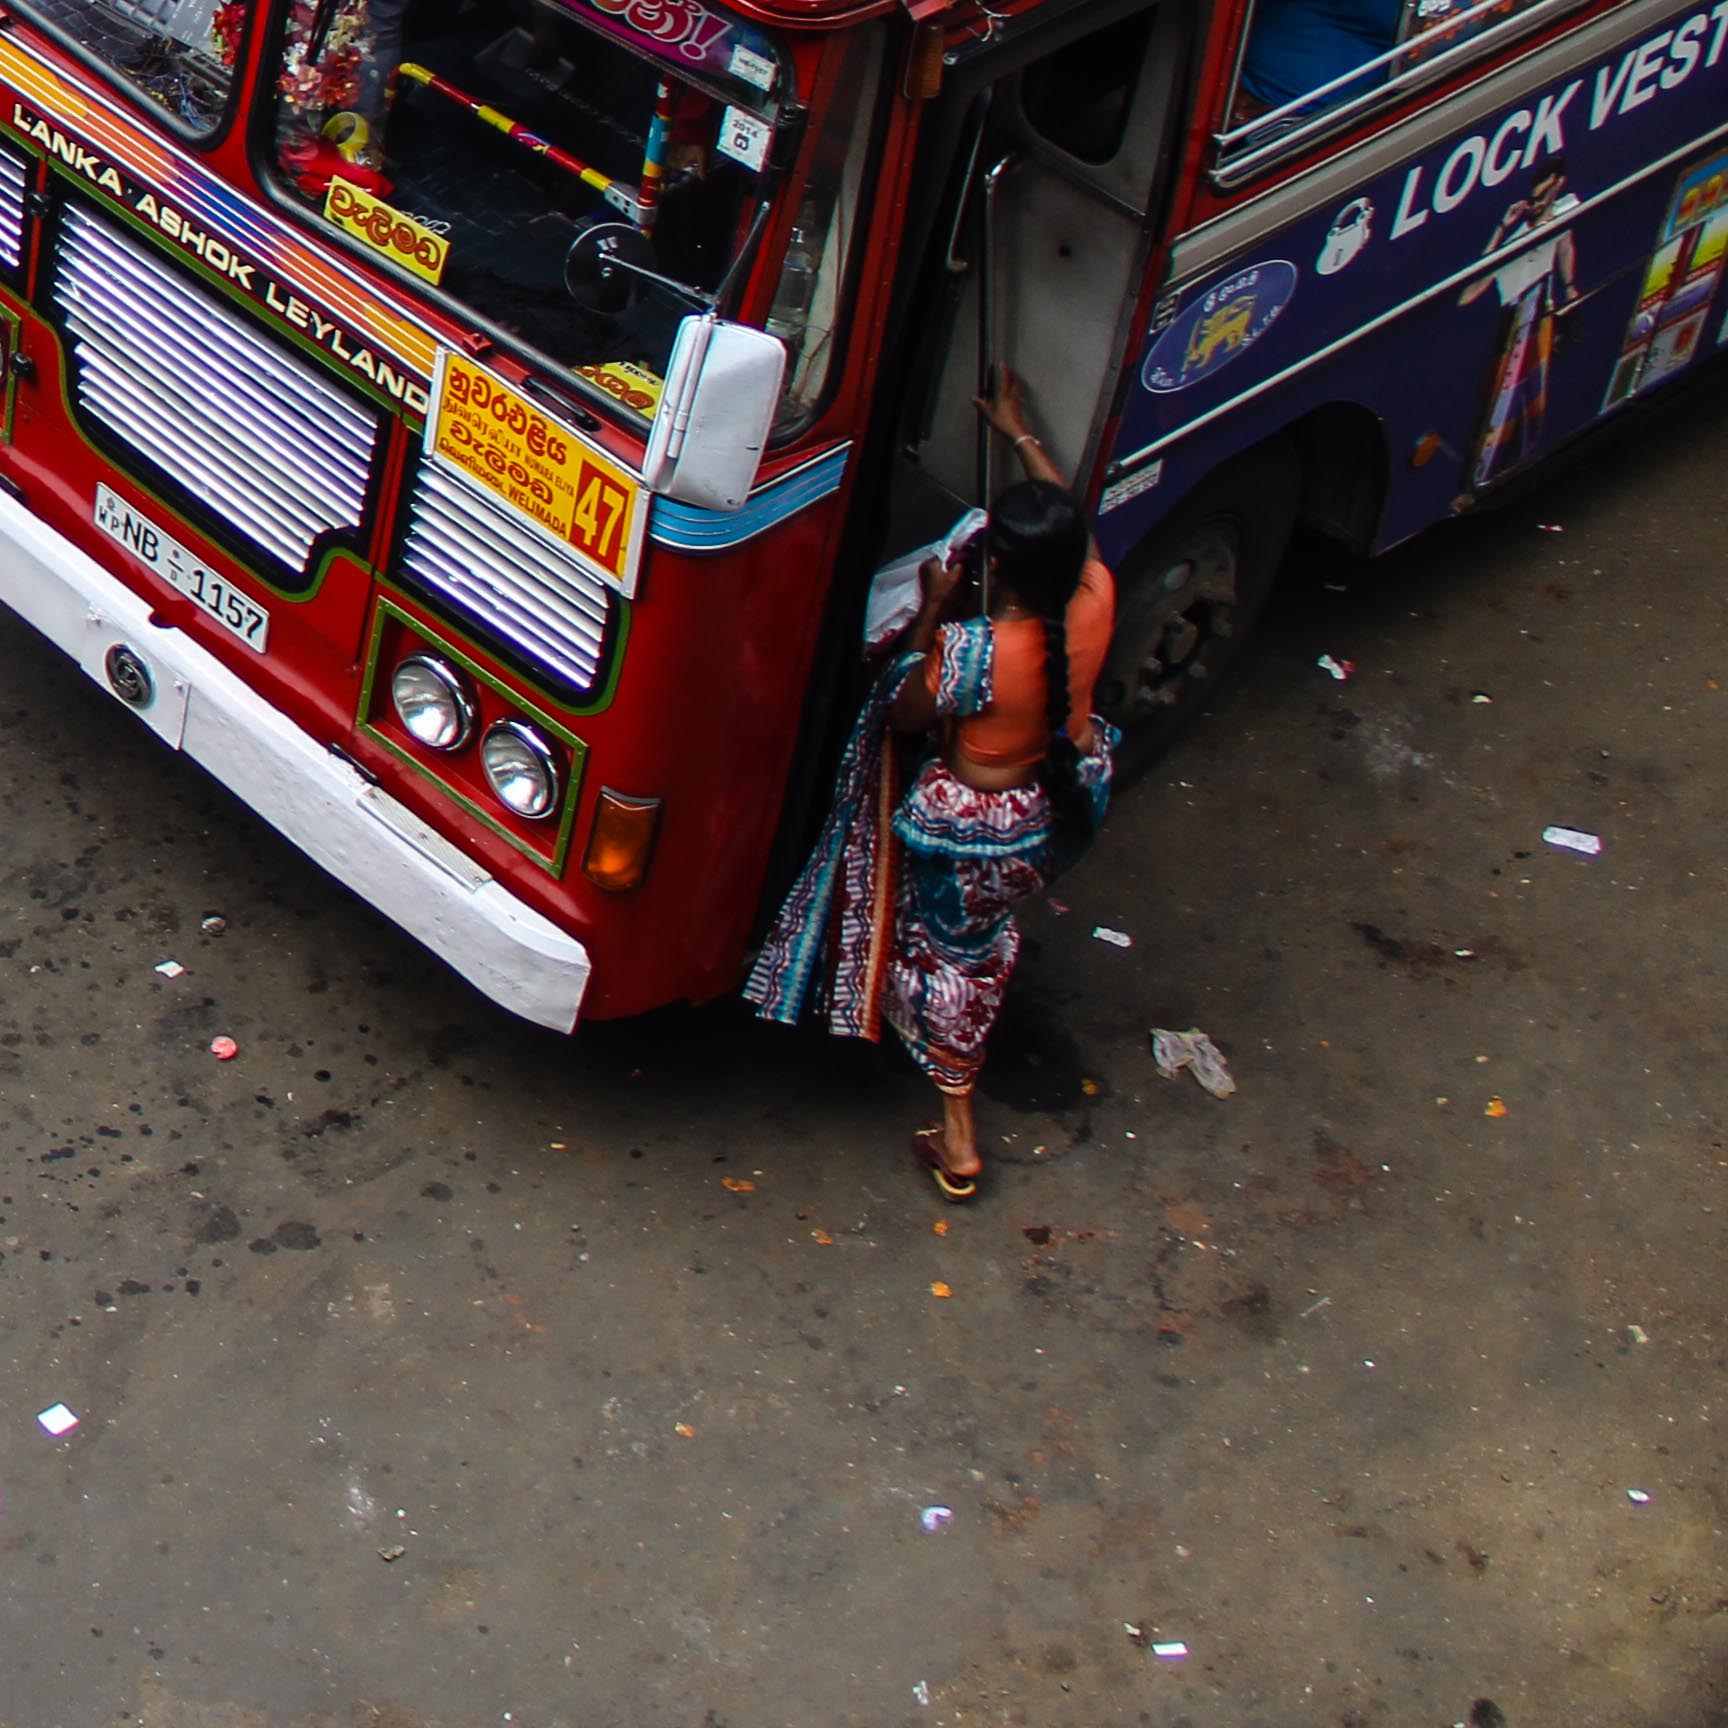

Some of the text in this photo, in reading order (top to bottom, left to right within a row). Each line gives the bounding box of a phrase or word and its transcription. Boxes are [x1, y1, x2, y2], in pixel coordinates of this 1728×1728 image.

[1390, 78, 1584, 241] LOCK
[12, 103, 432, 415] LANKA ASHOK LEYLAND
[328, 183, 443, 270] වැලිමඩ
[449, 366, 567, 467] නුවරඑළිය
[449, 420, 554, 506] වැලිමඩ
[523, 452, 576, 498] NUWARA ELIYA
[508, 482, 568, 536] WELIMADA
[575, 475, 627, 558] 47
[123, 512, 159, 563] NB
[189, 568, 264, 639] 1157
